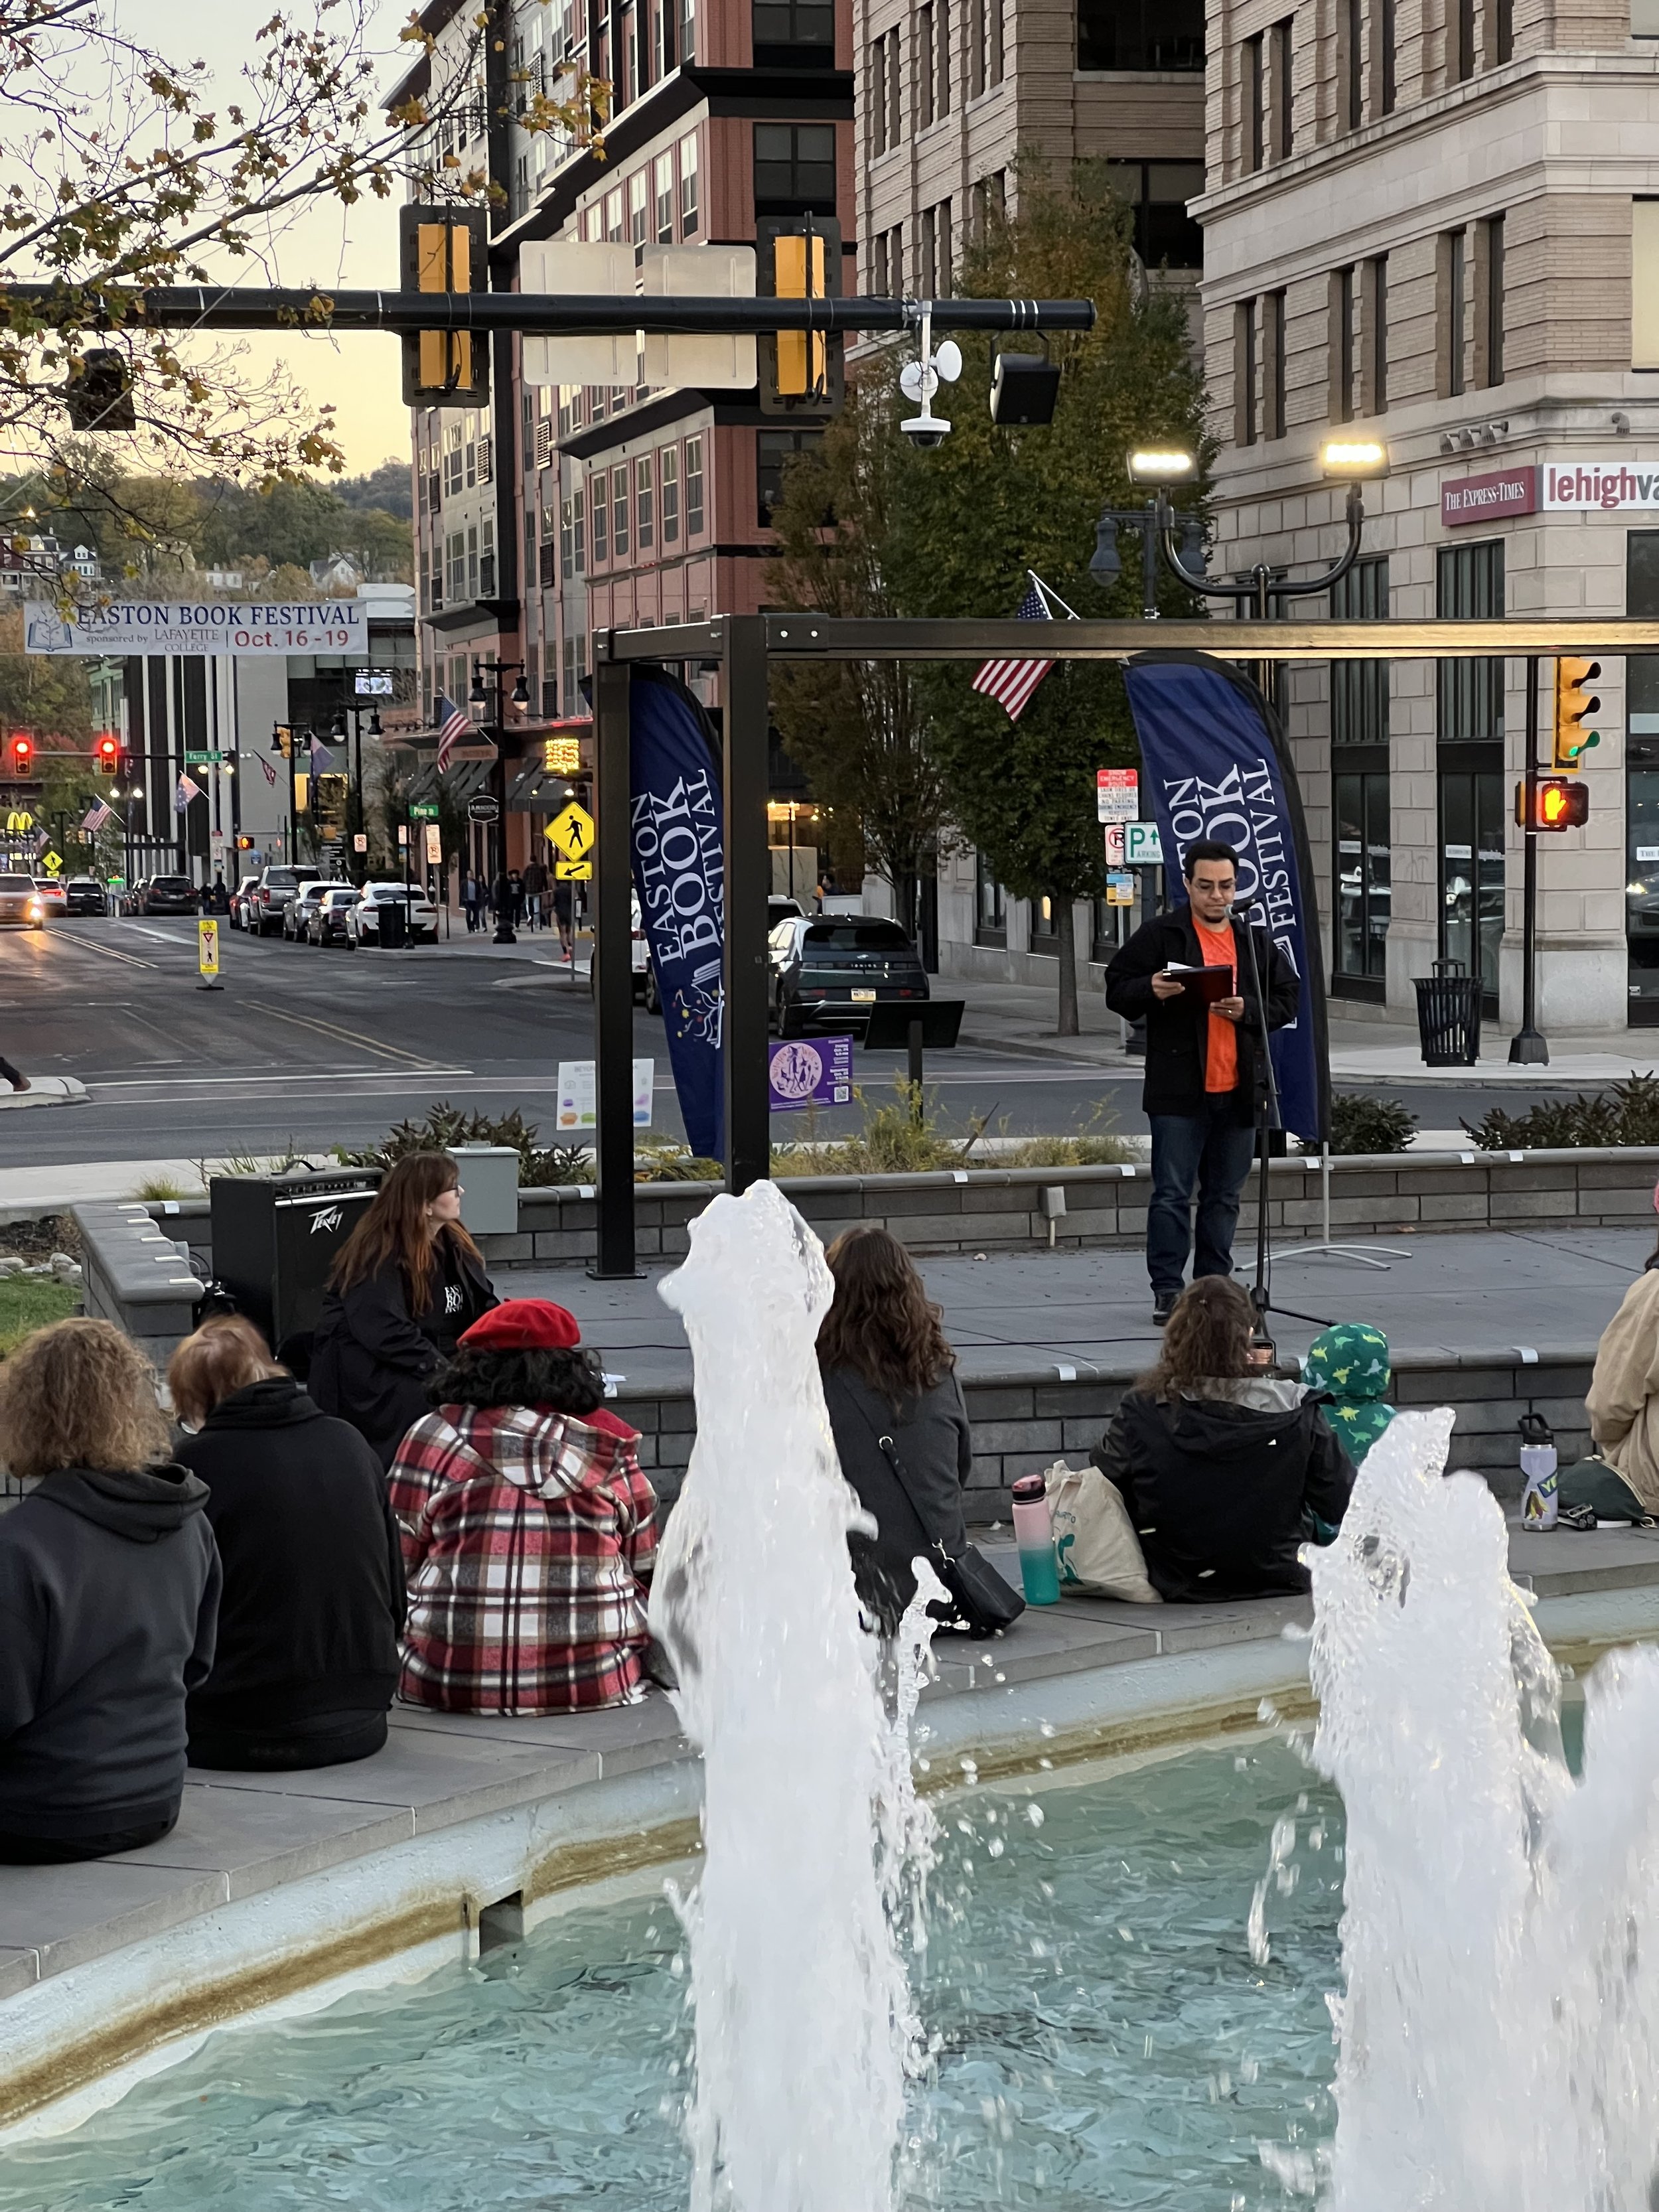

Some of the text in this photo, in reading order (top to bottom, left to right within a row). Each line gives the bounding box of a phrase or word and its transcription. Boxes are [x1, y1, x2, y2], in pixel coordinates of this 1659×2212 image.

[1445, 481, 1524, 510] THE EXPRESS-TIMES
[78, 606, 359, 625] EASTON BOOK FESTIVAL
[137, 634, 148, 643] by
[155, 629, 219, 640] LAFAYETTE
[235, 630, 278, 647] Oct.
[165, 644, 209, 652] COLLEGE
[1242, 759, 1297, 932] FESTIVAL
[648, 776, 721, 960] BOOK
[630, 792, 684, 968] EASTON
